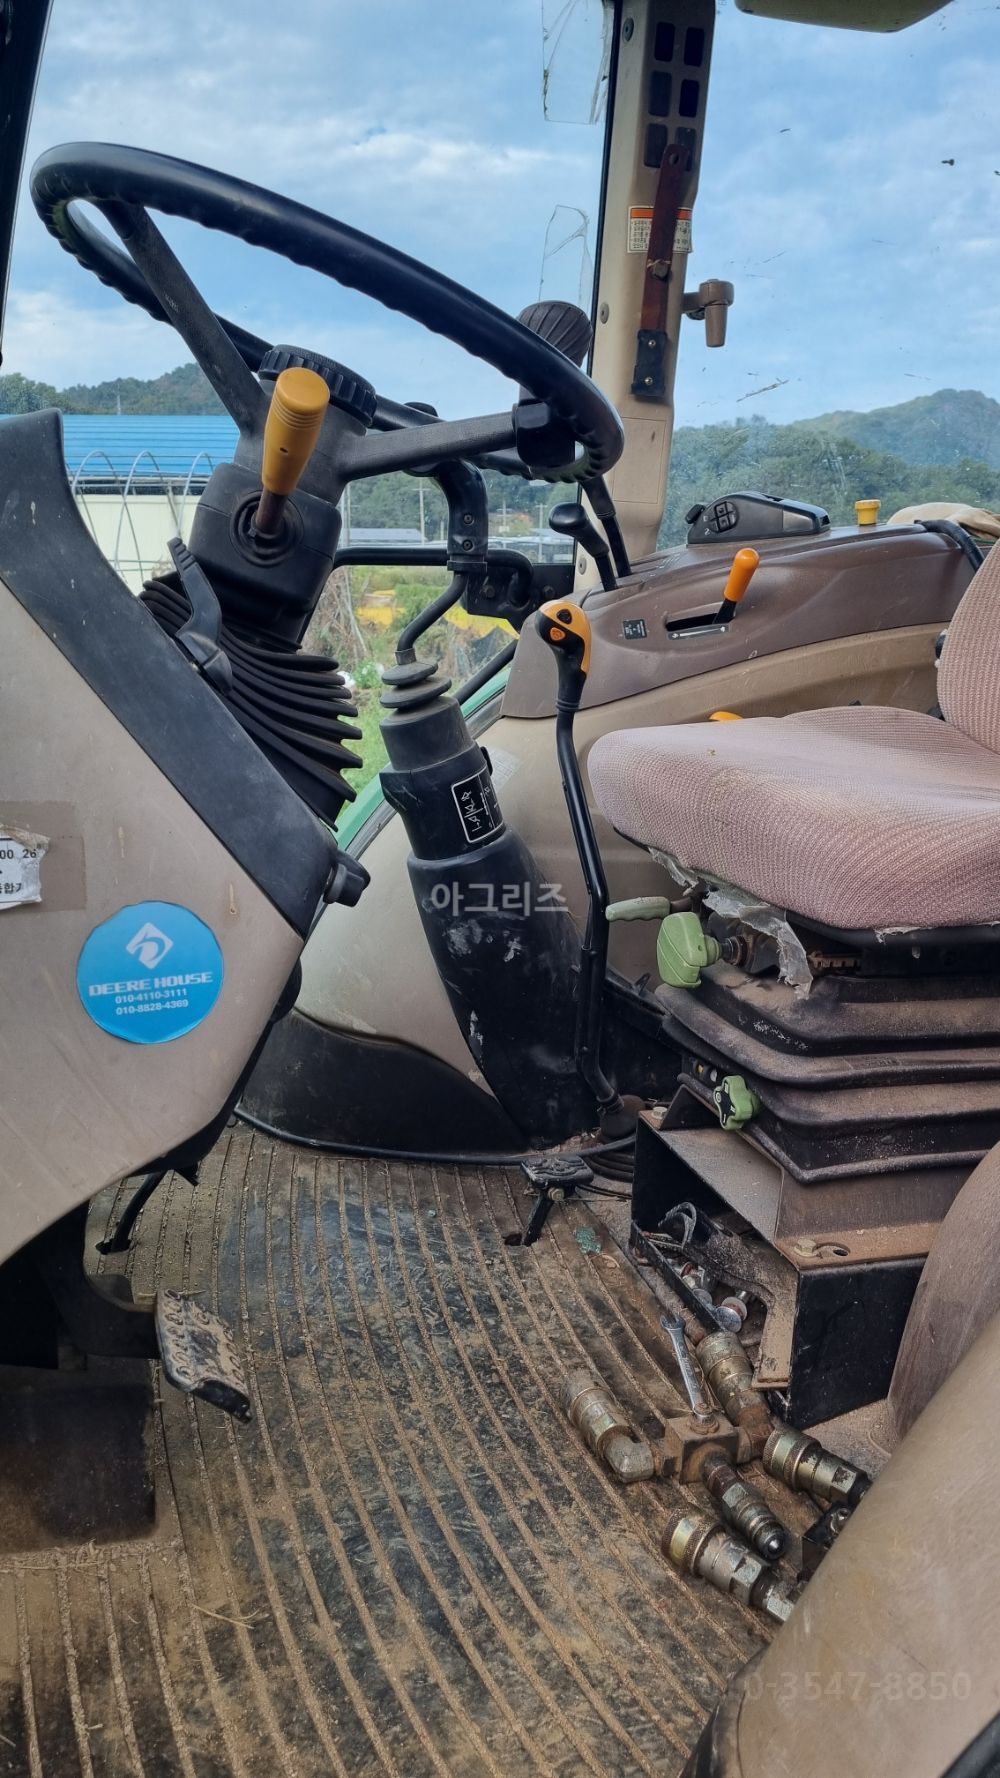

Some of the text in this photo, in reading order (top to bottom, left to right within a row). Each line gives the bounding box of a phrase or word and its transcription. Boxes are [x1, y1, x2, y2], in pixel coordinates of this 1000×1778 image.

[89, 972, 213, 996] DEERE HOUSE
[115, 988, 187, 1004] 010-4110-3111
